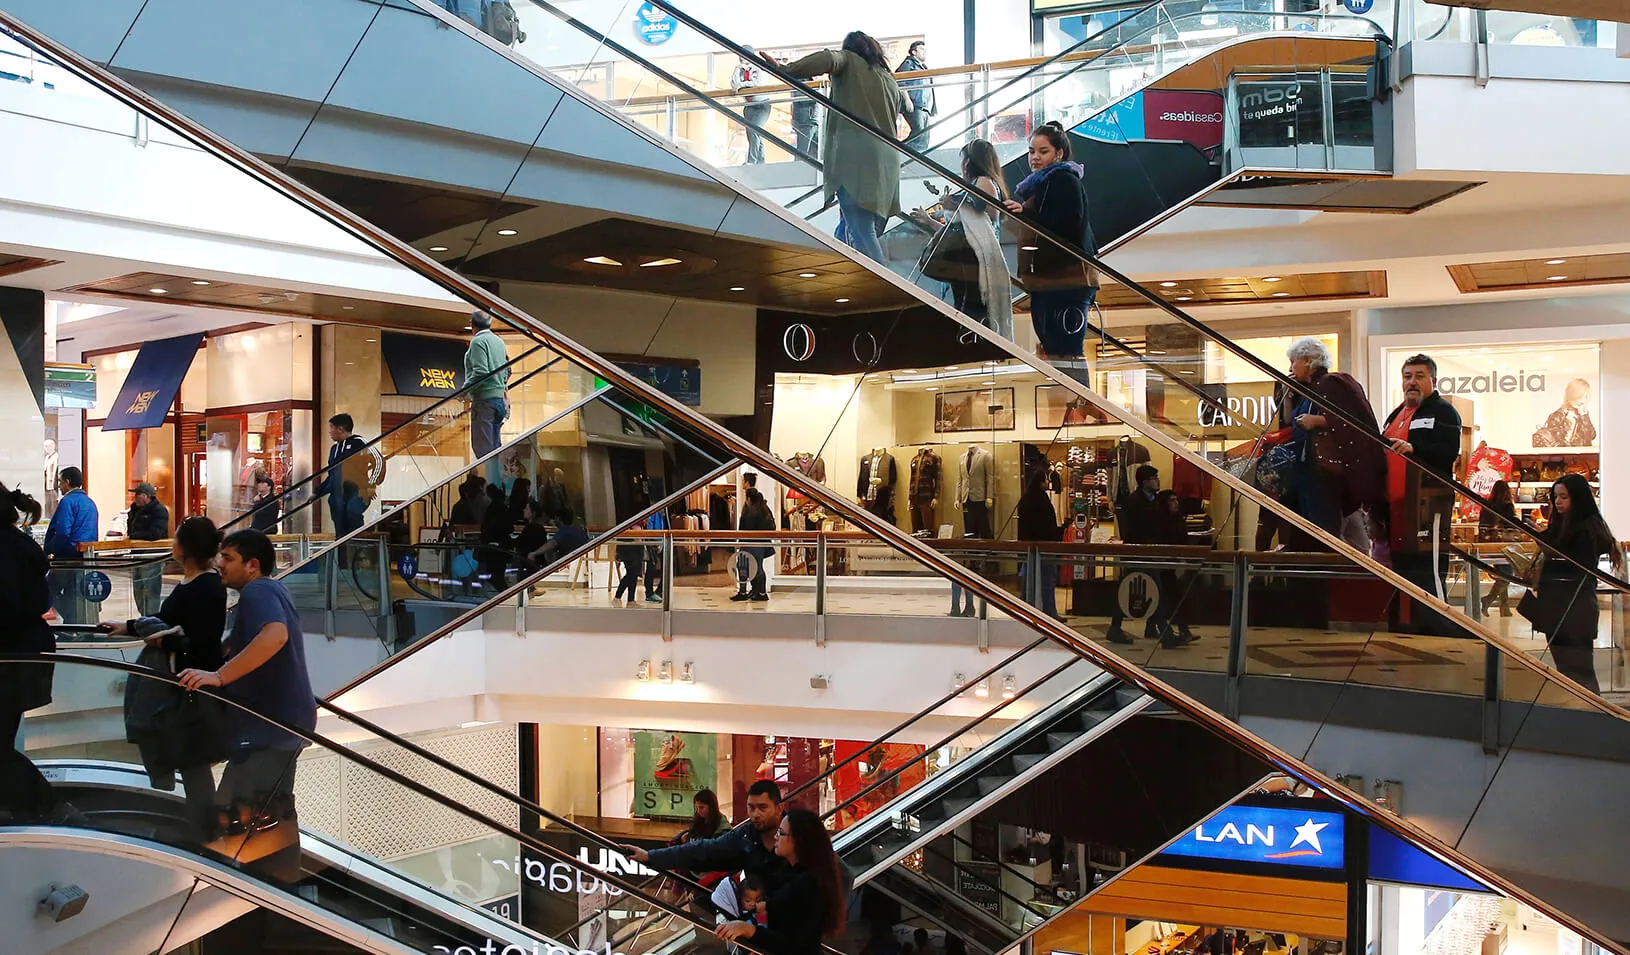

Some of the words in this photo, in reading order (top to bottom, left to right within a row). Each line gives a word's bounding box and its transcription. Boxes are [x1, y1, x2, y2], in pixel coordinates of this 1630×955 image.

[641, 23, 671, 33] adidas
[1243, 111, 1254, 120] te
[1254, 105, 1284, 119] queda
[85, 373, 94, 381] 2
[1437, 370, 1546, 394] azaleia
[1195, 822, 1274, 847] LAN
